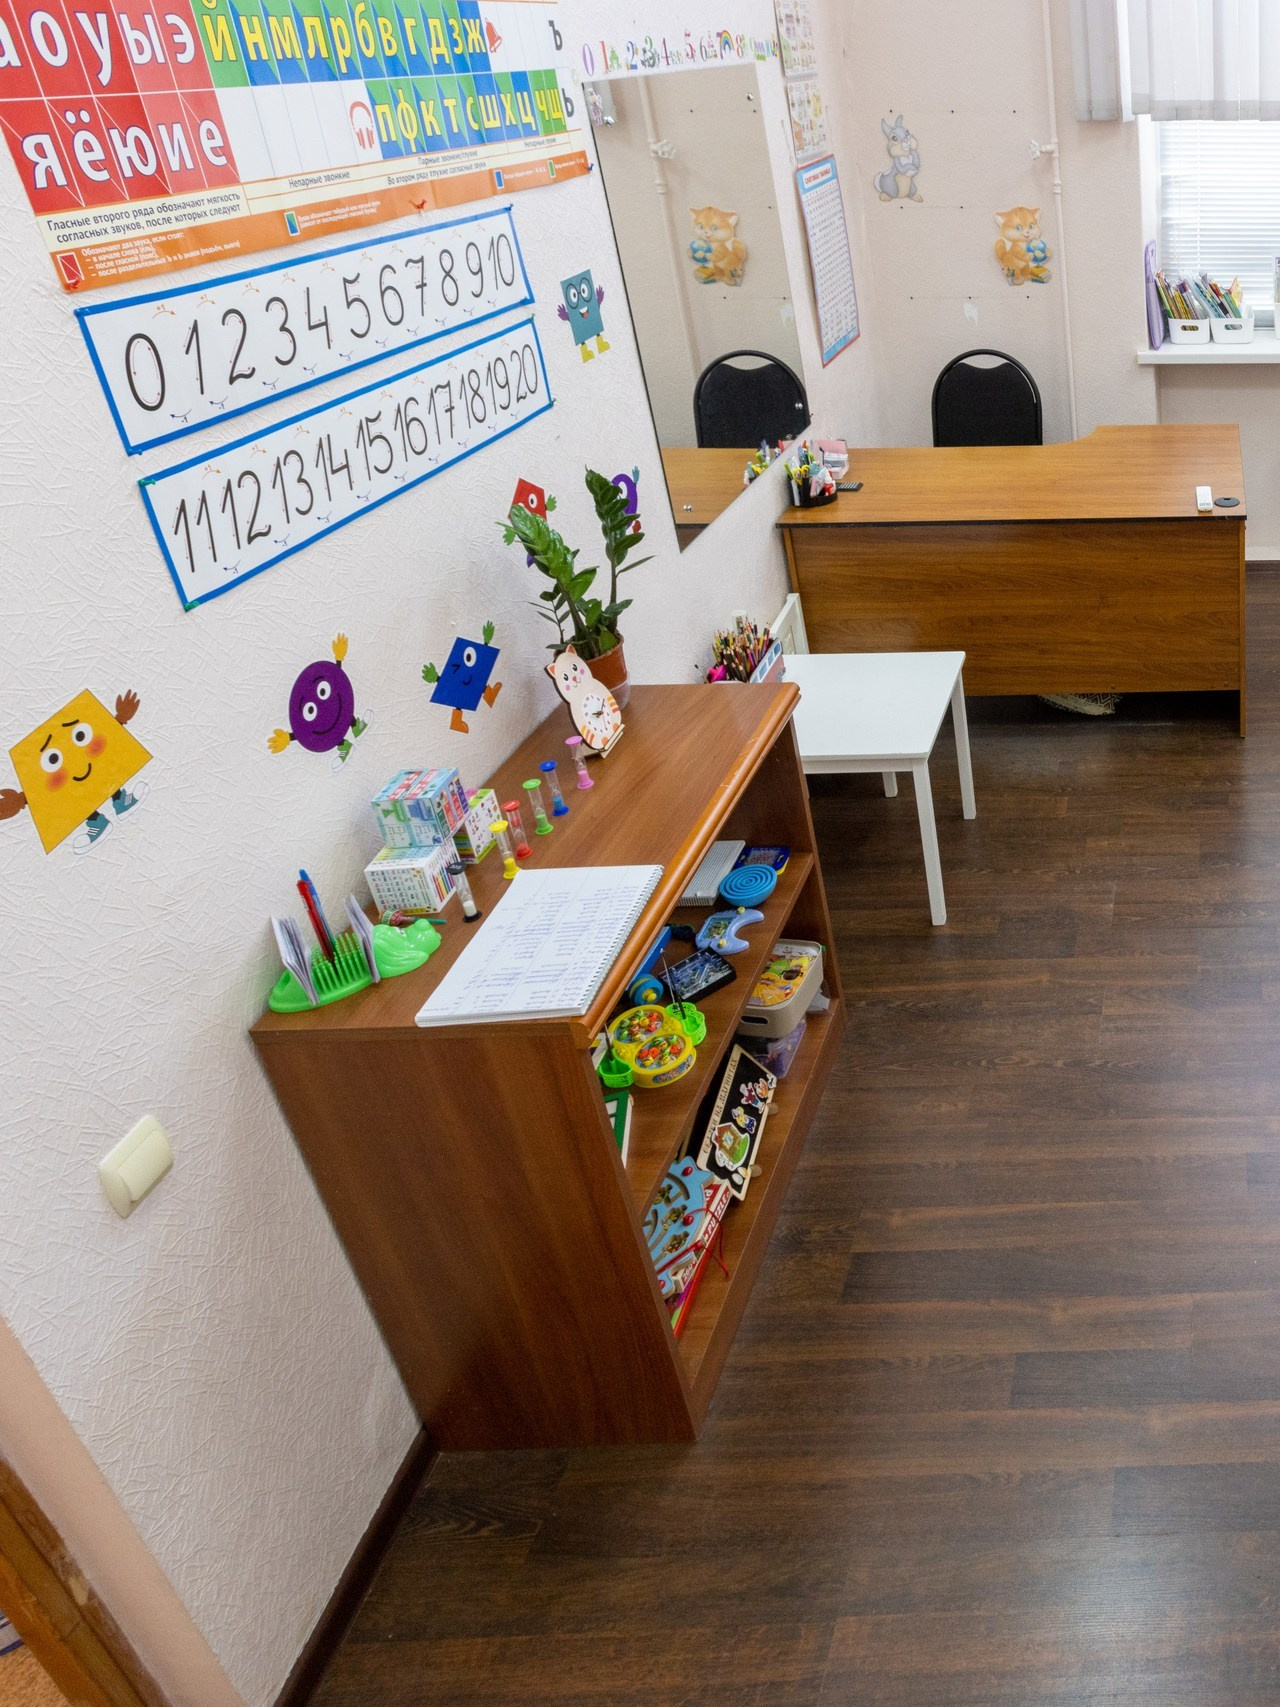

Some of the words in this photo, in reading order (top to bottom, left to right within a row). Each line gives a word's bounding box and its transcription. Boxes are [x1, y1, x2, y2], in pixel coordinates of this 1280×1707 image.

[29, 10, 69, 67] о
[75, 11, 112, 87] у
[118, 13, 166, 65] ы
[164, 13, 195, 64] э
[239, 15, 270, 61] н
[268, 16, 303, 60] м
[302, 16, 329, 59] л
[329, 16, 351, 73] р
[354, 2, 375, 58] б
[377, 16, 398, 57] в
[403, 18, 417, 55] г
[428, 18, 450, 64] д
[448, 18, 464, 54] з
[462, 18, 486, 53] ж
[22, 133, 68, 189] я
[64, 109, 111, 182] ё
[108, 125, 158, 178] ю
[157, 122, 195, 172] и
[198, 118, 228, 167] е
[375, 103, 397, 143] п
[396, 88, 418, 153] ф
[420, 100, 442, 137] к
[443, 98, 459, 134] т
[465, 96, 479, 131] с
[478, 95, 501, 129] ш
[500, 93, 517, 126] х
[516, 91, 537, 131] ц
[535, 90, 550, 121] ч
[547, 88, 566, 126] щ
[288, 174, 322, 189] Непарные
[323, 170, 350, 183] звонкие
[47, 213, 91, 232] Гласные
[93, 210, 130, 225] второго
[133, 206, 155, 224] ряда
[156, 196, 206, 214] обозначают
[206, 191, 240, 207] мягкость
[56, 227, 109, 244] согласных
[111, 221, 145, 238] звуков,
[146, 215, 173, 230] после
[174, 209, 208, 224] которых
[209, 203, 241, 218] следуют
[125, 333, 165, 411] 0
[184, 319, 204, 395] 1
[222, 308, 256, 385] 2
[265, 296, 297, 366] 3
[306, 286, 331, 350] 4
[342, 272, 371, 339] 5
[379, 264, 404, 326] 6
[404, 255, 427, 317] 7
[439, 249, 459, 306] 8
[465, 241, 484, 298] 9
[488, 233, 515, 291] 10
[174, 489, 217, 573] 11
[221, 470, 272, 550] 12
[272, 450, 314, 524] 13
[315, 433, 353, 502] 14
[356, 410, 394, 482] 15
[394, 396, 428, 463] 16
[427, 380, 455, 445] 17
[459, 368, 487, 429] 18
[486, 356, 511, 416] 19
[510, 343, 538, 404] 20
